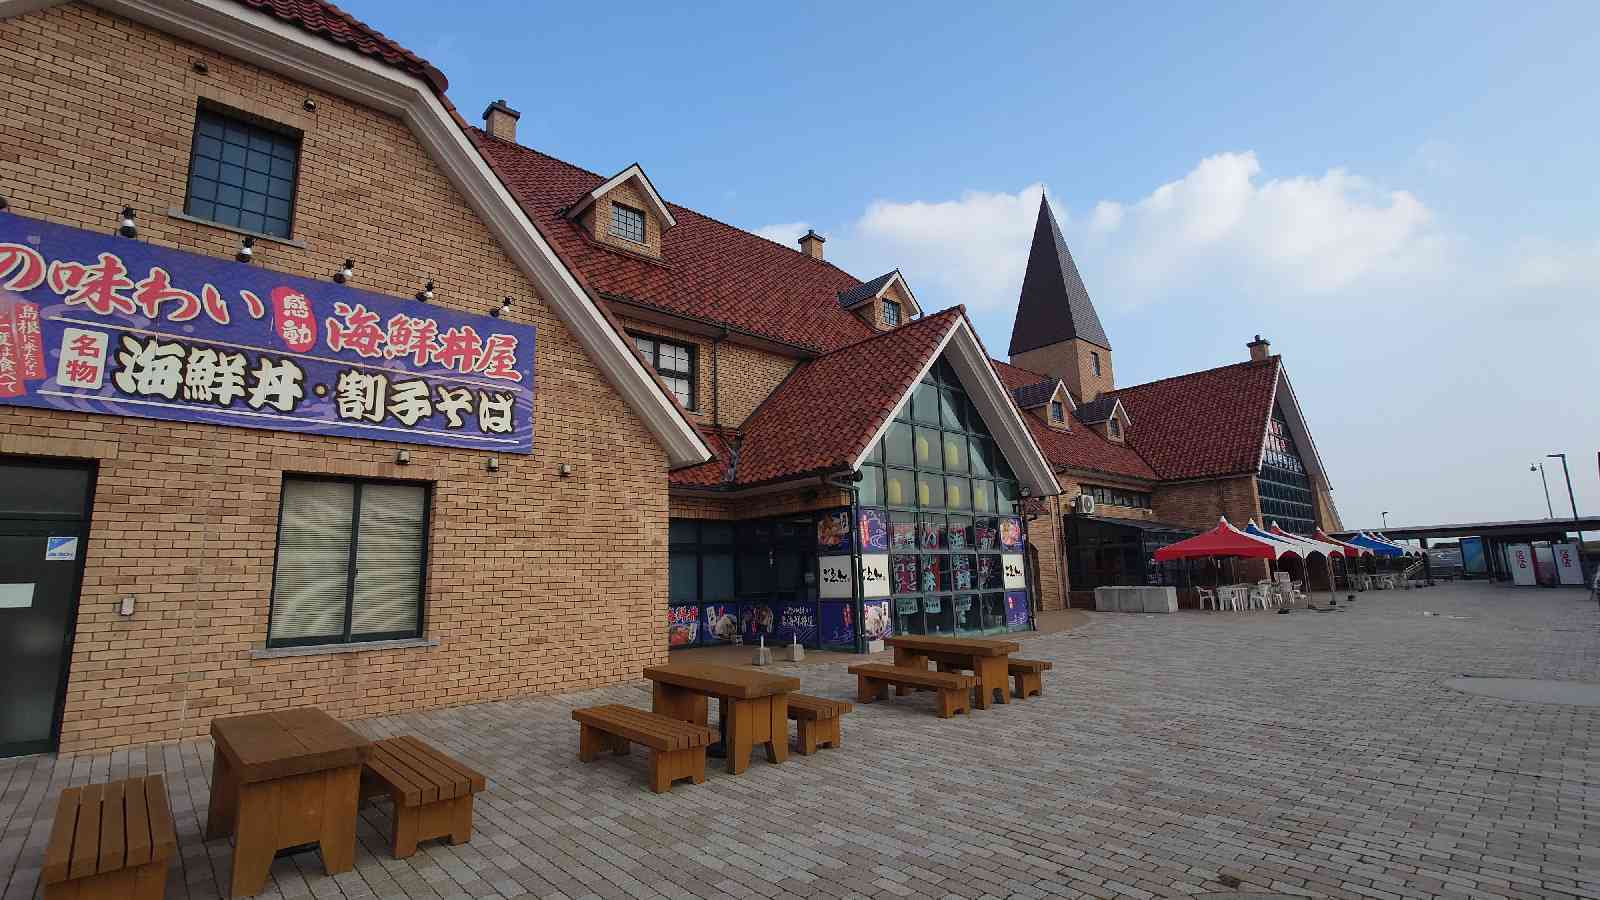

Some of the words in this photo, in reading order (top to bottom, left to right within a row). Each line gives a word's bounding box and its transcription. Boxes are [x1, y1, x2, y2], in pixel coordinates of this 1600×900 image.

[0, 243, 264, 324] の味わい
[283, 294, 312, 345] 感動
[326, 302, 522, 382] 海鮮丼屋
[66, 334, 101, 384] 名物
